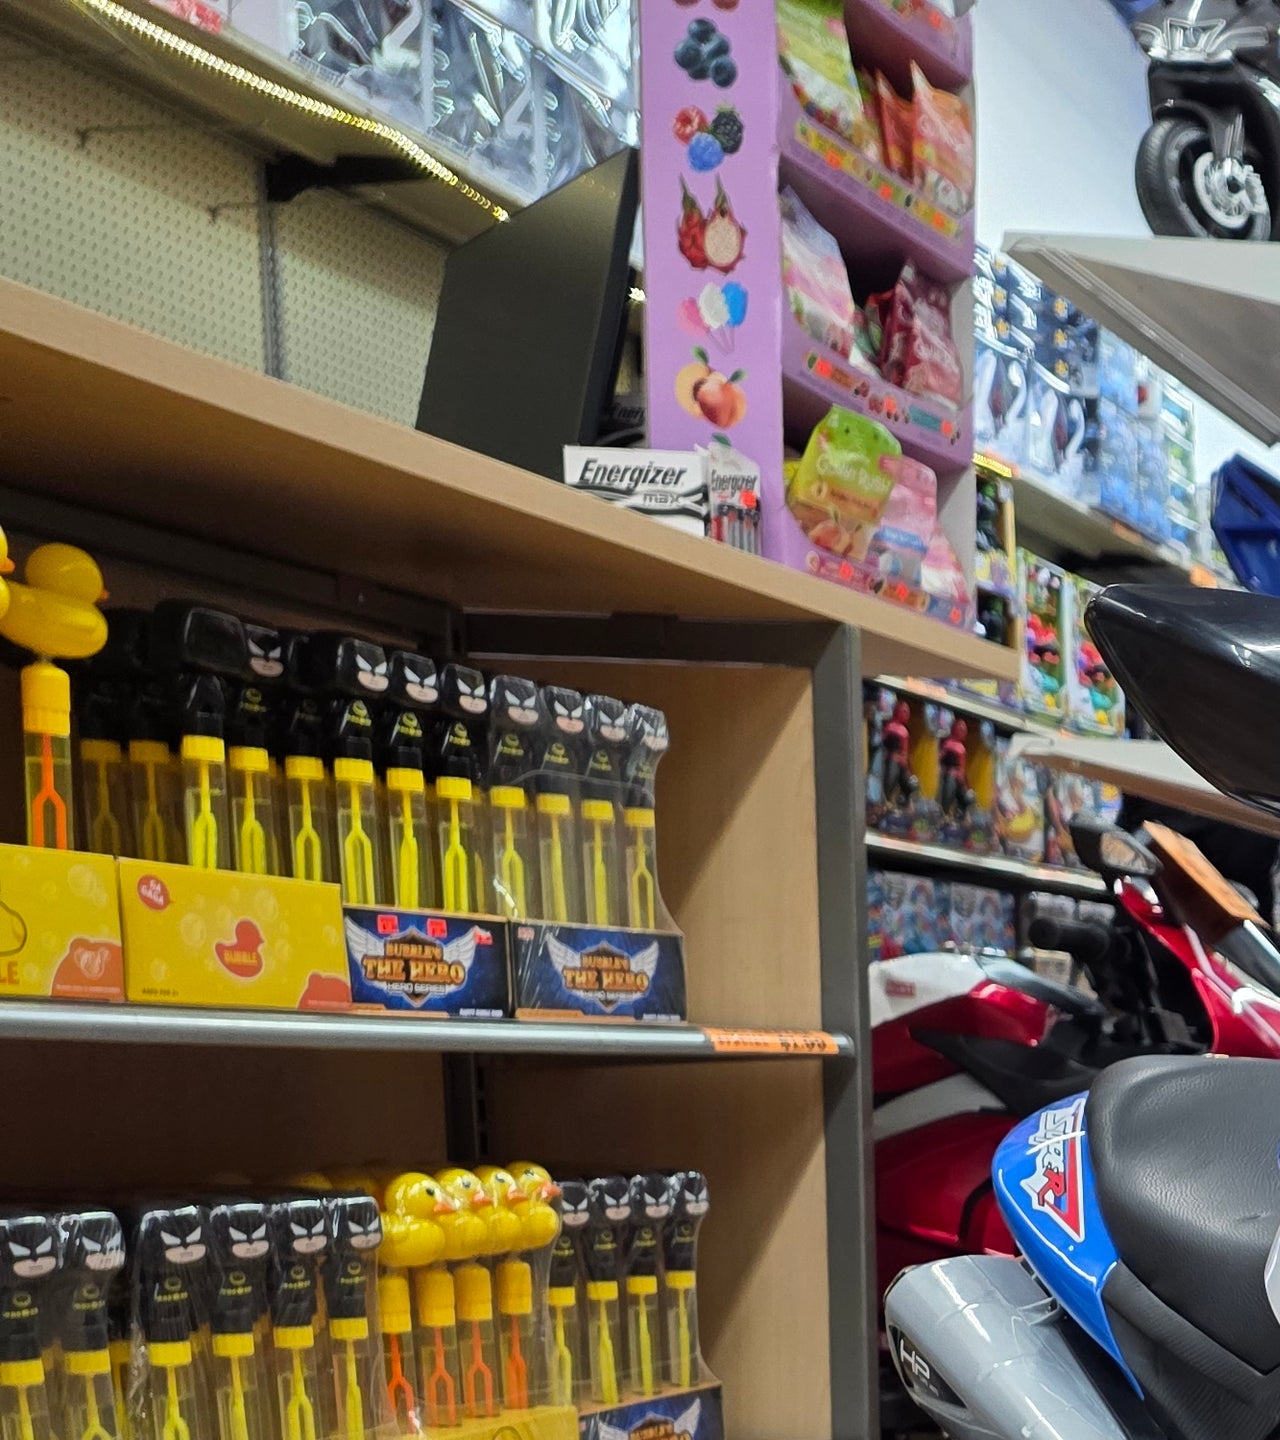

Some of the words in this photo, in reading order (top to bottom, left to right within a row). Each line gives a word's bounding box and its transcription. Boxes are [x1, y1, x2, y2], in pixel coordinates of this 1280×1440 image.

[579, 458, 688, 489] Energizer
[711, 469, 758, 496] Energizer
[223, 950, 258, 964] BUBBLE
[363, 959, 405, 981] THE
[410, 961, 465, 984] HERO
[564, 969, 599, 988] THE
[602, 970, 649, 991] HERO
[900, 1338, 930, 1379] HP
